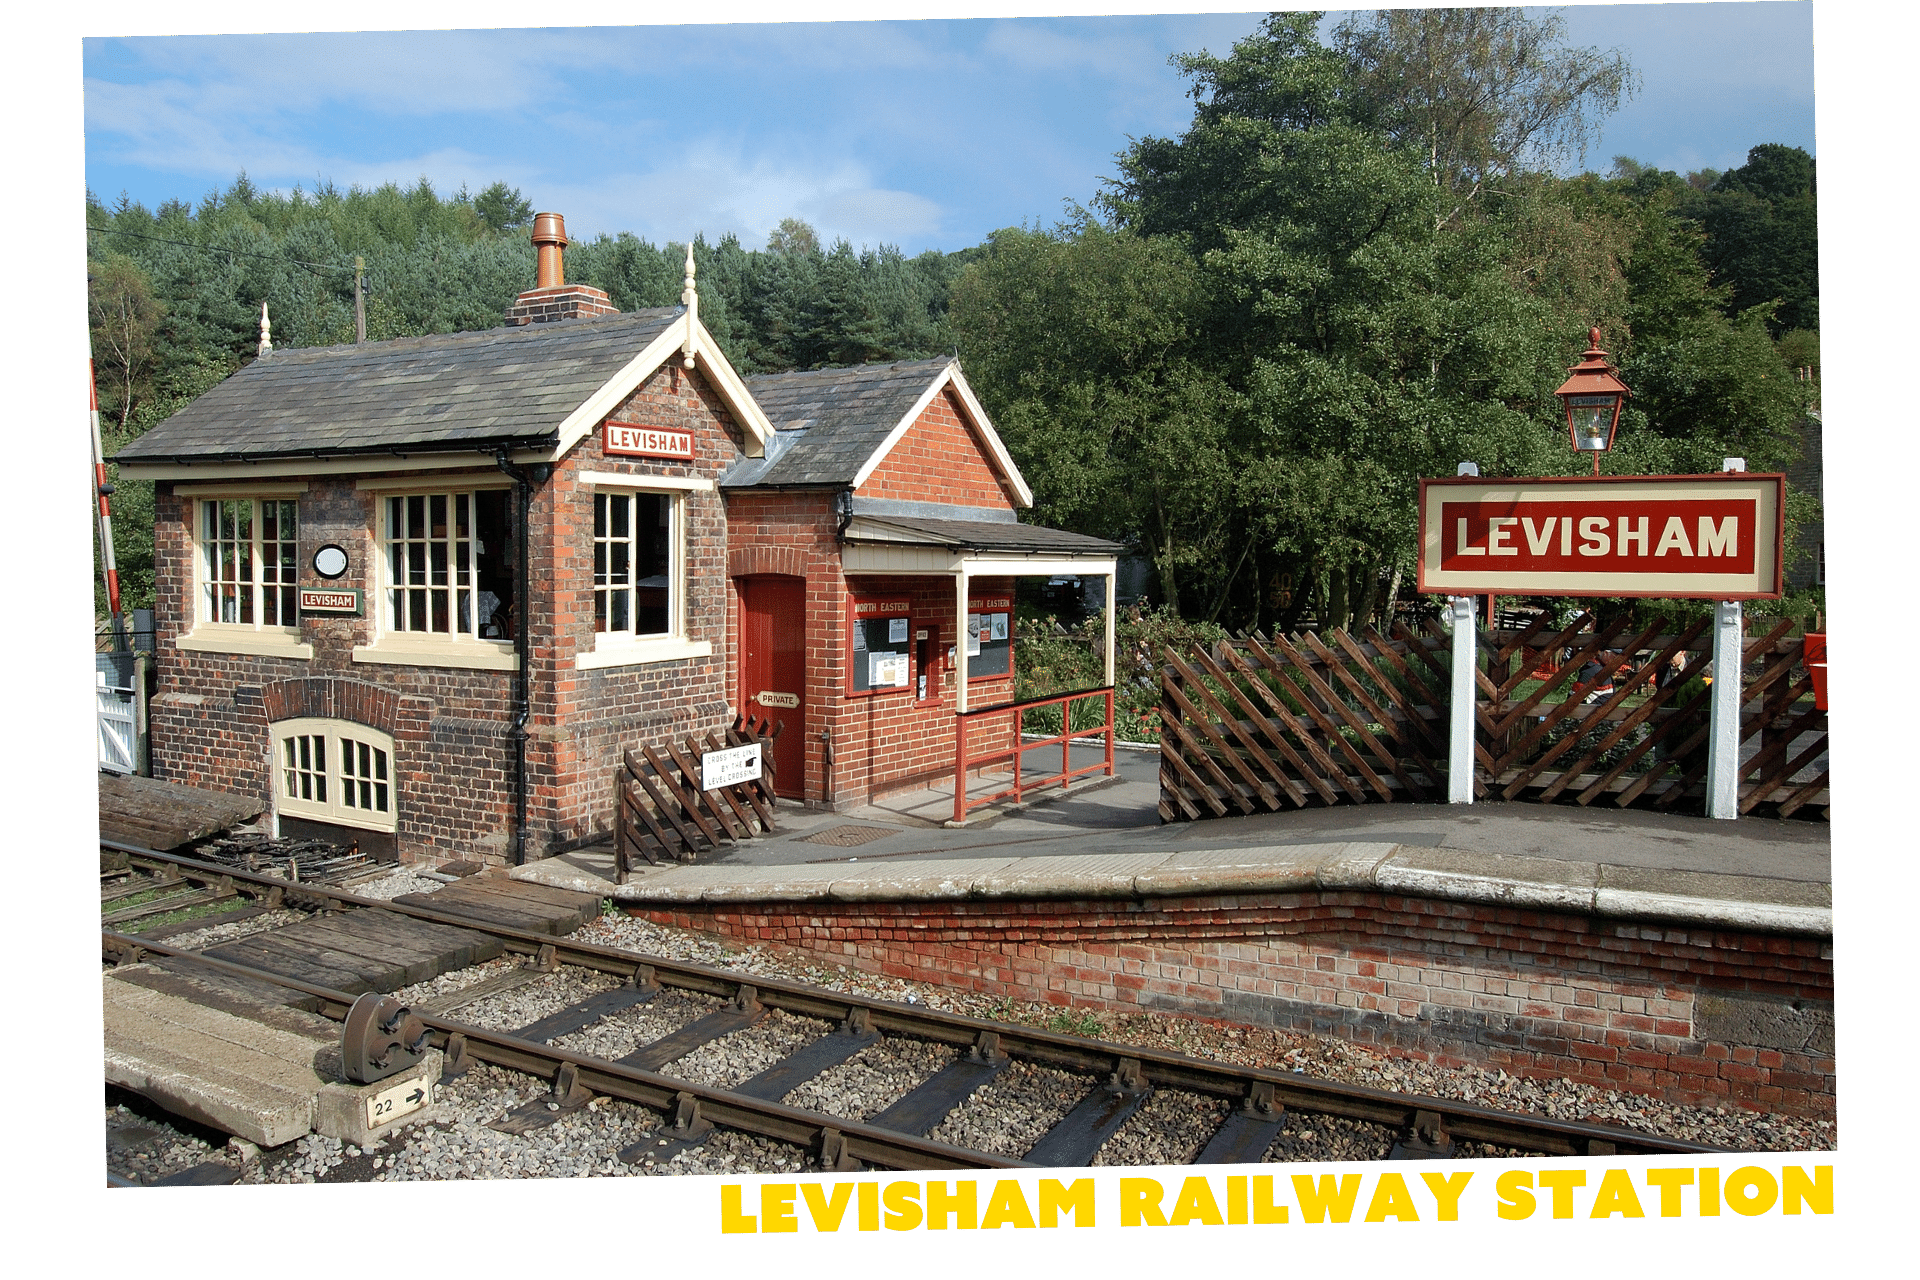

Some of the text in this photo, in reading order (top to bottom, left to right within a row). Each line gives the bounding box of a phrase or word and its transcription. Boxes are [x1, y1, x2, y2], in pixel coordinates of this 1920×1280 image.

[611, 429, 688, 452] LEVISHAM
[1456, 515, 1739, 558] LEVISHAM
[304, 594, 352, 607] LEVISHAM
[855, 602, 910, 613] NORTH EASTERN
[986, 598, 1010, 608] EASTERN
[762, 694, 794, 705] PRIVATE
[707, 748, 756, 765] CROSS THE LINE
[721, 760, 743, 773] BY THE
[707, 768, 757, 786] LEVEL CROSSING
[375, 1099, 393, 1116] 22
